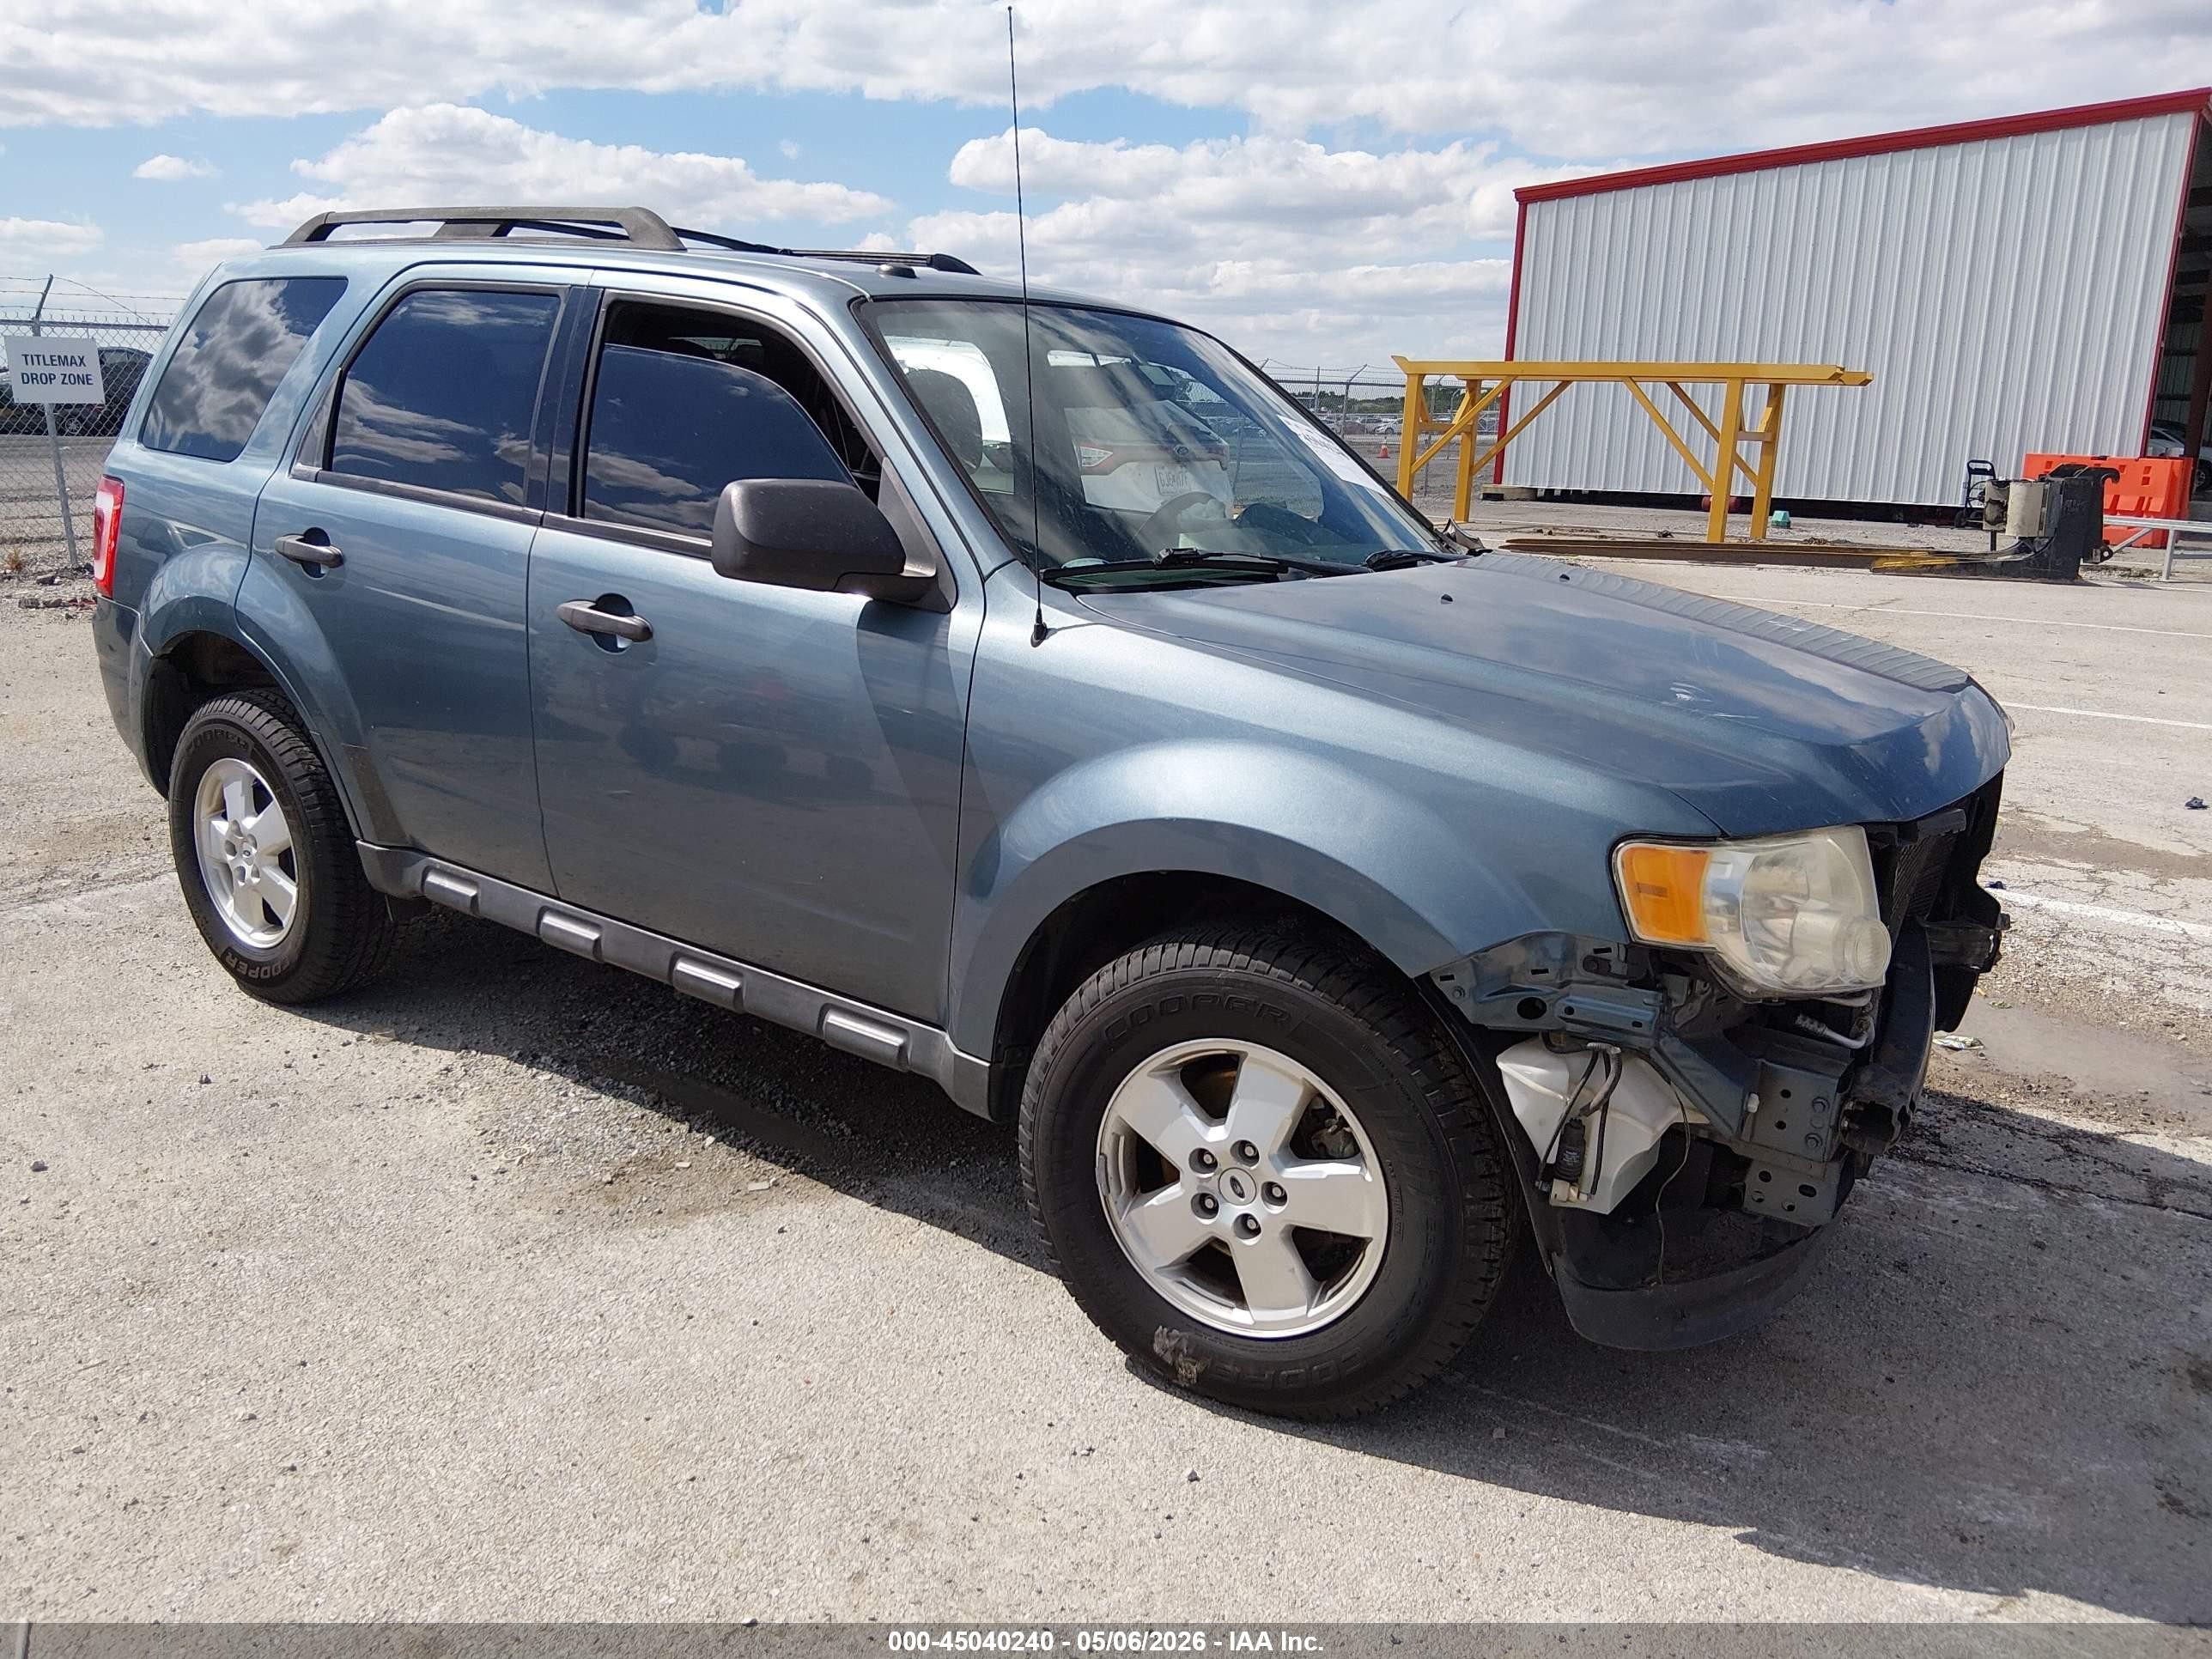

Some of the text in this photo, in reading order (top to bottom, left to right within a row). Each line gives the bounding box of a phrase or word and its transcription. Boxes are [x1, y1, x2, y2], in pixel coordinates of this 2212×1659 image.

[21, 354, 87, 367] TITLEMAX
[21, 373, 94, 385] DROP ZONE
[1104, 992, 1291, 1038] COOPER
